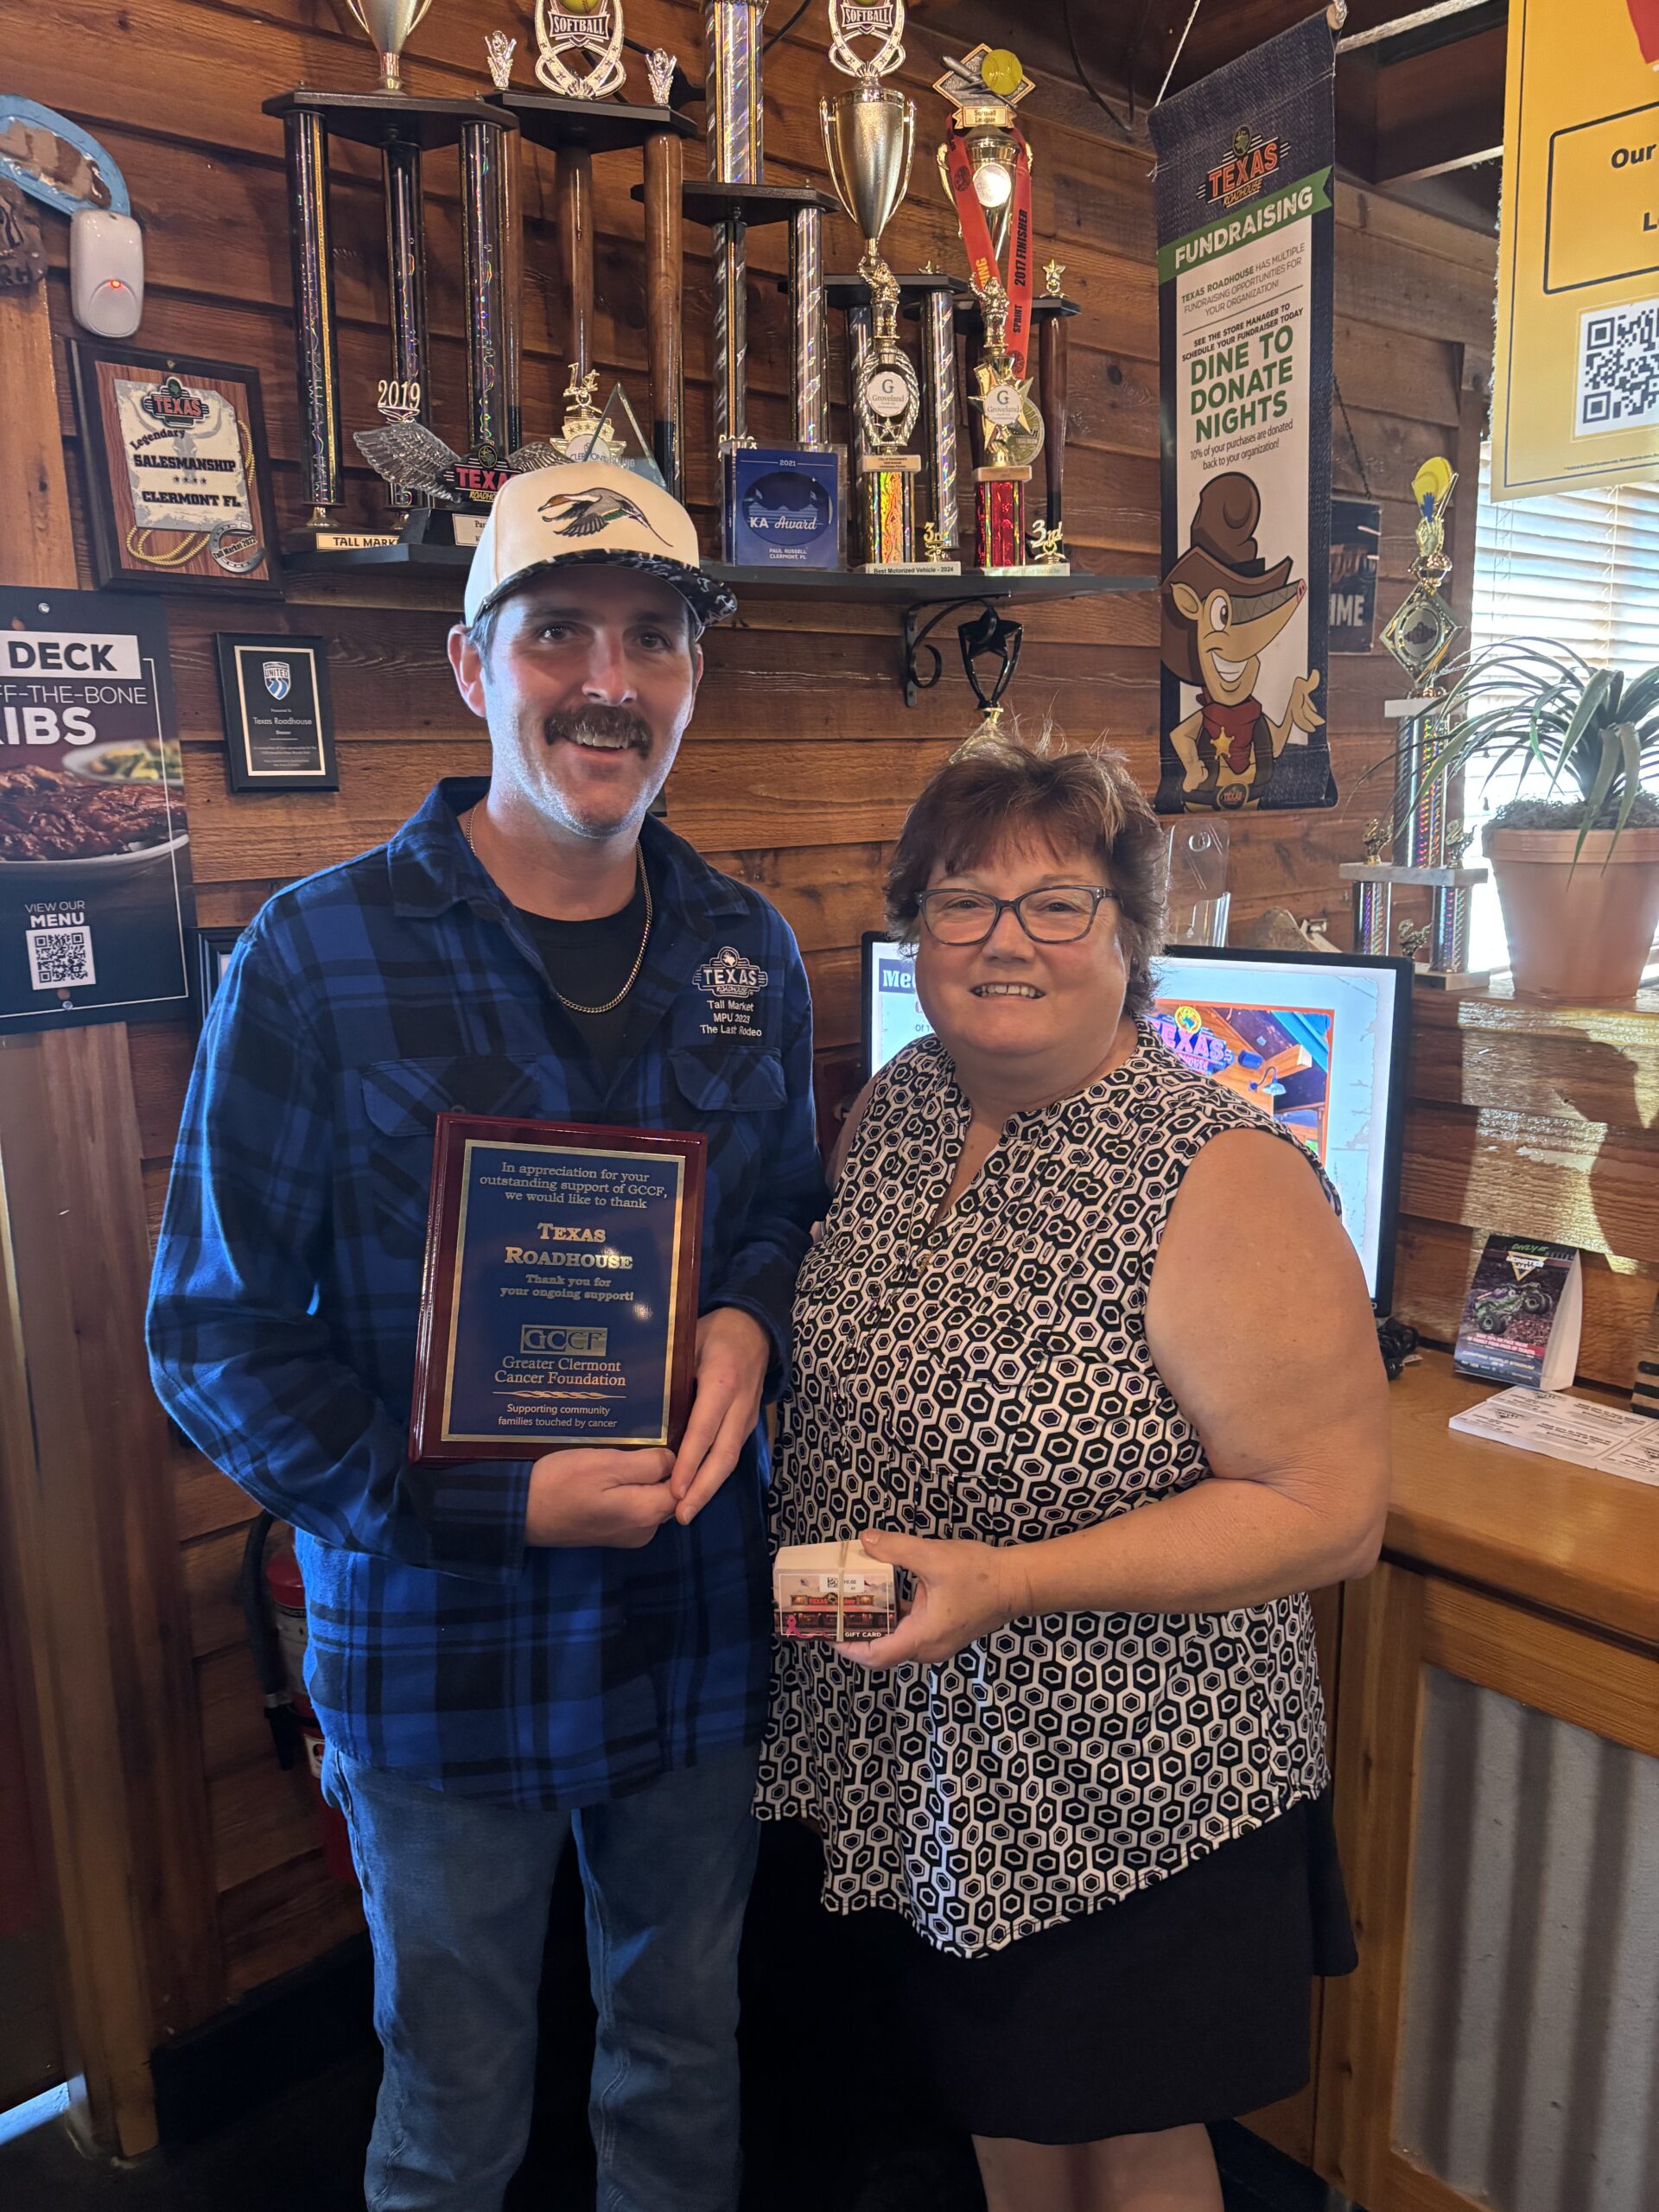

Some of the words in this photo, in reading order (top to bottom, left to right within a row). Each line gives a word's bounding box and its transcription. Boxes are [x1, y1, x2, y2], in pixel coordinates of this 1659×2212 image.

[554, 16, 605, 35] SOFTBALL
[845, 8, 889, 23] SOFTBALL
[1611, 143, 1657, 168] Our
[1209, 142, 1278, 198] TEXAS
[1223, 178, 1263, 207] ROADHOUSE
[1016, 208, 1028, 260] FINISHER
[1175, 186, 1313, 270] FUNDRAISING
[1014, 260, 1026, 287] 2017
[1181, 287, 1205, 303] TEXAS
[1206, 265, 1255, 293] ROADHOUSE
[1255, 257, 1271, 271] HAS
[1271, 242, 1306, 264] MULTIPLE
[1184, 288, 1230, 315] FUNDRAISING
[1231, 265, 1286, 296] OPPORTUNITIES
[1287, 257, 1302, 270] FOR
[1205, 302, 1225, 317] YOUR
[1226, 280, 1279, 309] ORGANIZATION!
[1013, 304, 1023, 334] SPRINT
[1193, 338, 1206, 347] SEE
[1208, 331, 1221, 342] THE
[1223, 322, 1244, 337] STORE
[1245, 308, 1279, 327] MANAGER
[1281, 302, 1291, 315] TO
[1182, 344, 1218, 362] SCHEDULE
[1217, 336, 1236, 350] YOUR
[1236, 319, 1279, 341] FUNDRAISER
[1280, 307, 1304, 325] TODAY
[1191, 341, 1249, 386] DINE
[1259, 325, 1294, 360] TO
[378, 379, 421, 410] 2019
[882, 378, 894, 393] G
[1191, 355, 1294, 416] DONATE
[153, 395, 202, 416] TEXAS
[996, 391, 1009, 404] G
[1196, 390, 1287, 443] NIGHTS
[130, 428, 185, 451] Legendary
[1190, 448, 1203, 461] 10%
[1203, 446, 1211, 457] of
[1210, 442, 1225, 457] your
[1226, 433, 1256, 454] purchases
[1257, 430, 1267, 439] are
[1268, 418, 1294, 437] donated
[133, 454, 236, 473] SALESMANSHIP
[569, 452, 607, 462] CLERONT
[1203, 458, 1217, 470] back
[1218, 455, 1225, 465] to
[1226, 452, 1241, 467] your
[1241, 438, 1280, 461] organization!
[456, 467, 519, 491] TEXA
[142, 491, 219, 505] CLERMONT
[223, 495, 241, 507] FL
[469, 491, 498, 501] ROADHO
[750, 517, 769, 528] KA
[774, 516, 817, 530] Award
[333, 537, 359, 547] TALL
[363, 537, 399, 547] MARK
[1030, 519, 1063, 548] 3rd
[213, 550, 225, 560] Tall
[223, 542, 243, 556] Market
[1329, 594, 1365, 626] IME
[8, 640, 118, 671] DECK
[264, 668, 289, 677] UNITED
[0, 684, 148, 704] F-THE-BONE
[0, 706, 96, 746] IBS
[252, 716, 273, 725] Texas
[274, 716, 313, 725] Roadhouse
[24, 902, 57, 913] VIEW
[59, 900, 86, 910] OUR
[30, 912, 85, 928] MENU
[703, 969, 757, 985] TEXAS
[716, 986, 748, 995] ROADHOUSE
[707, 1000, 725, 1009] Tall
[728, 1001, 754, 1012] Market
[714, 1013, 733, 1022] MPU
[734, 1014, 750, 1023] 2023
[700, 1025, 718, 1033] The
[721, 1025, 737, 1034] Last
[739, 1026, 762, 1037] Rodeo
[501, 1162, 515, 1173] In
[519, 1165, 597, 1179] appreciation
[601, 1169, 618, 1180] for
[620, 1173, 650, 1184] your
[480, 1176, 557, 1191] outstanding
[561, 1182, 609, 1194] support
[612, 1183, 626, 1194] of
[628, 1185, 668, 1199] GCCF,
[505, 1192, 522, 1201] we
[526, 1192, 564, 1204] would
[568, 1194, 591, 1205] like
[594, 1197, 607, 1206] to
[610, 1198, 647, 1209] thank
[537, 1223, 607, 1243] TEXAS
[505, 1246, 633, 1270] ROADHOUSE
[1506, 1255, 1545, 1268] MONSTER
[1516, 1262, 1536, 1271] JAM
[525, 1274, 565, 1285] Thank
[568, 1276, 590, 1287] you
[594, 1277, 612, 1287] for
[499, 1287, 529, 1298] your
[532, 1289, 582, 1301] ongoing
[583, 1290, 634, 1302] support!
[523, 1329, 602, 1351] GCCF
[502, 1356, 555, 1370] Greater
[557, 1357, 621, 1372] Clermont
[494, 1370, 544, 1384] Cancer
[548, 1372, 626, 1387] Foundation
[506, 1403, 558, 1415] Supporting
[561, 1405, 610, 1416] community
[498, 1416, 533, 1427] families
[535, 1417, 574, 1427] touched
[575, 1418, 587, 1428] by
